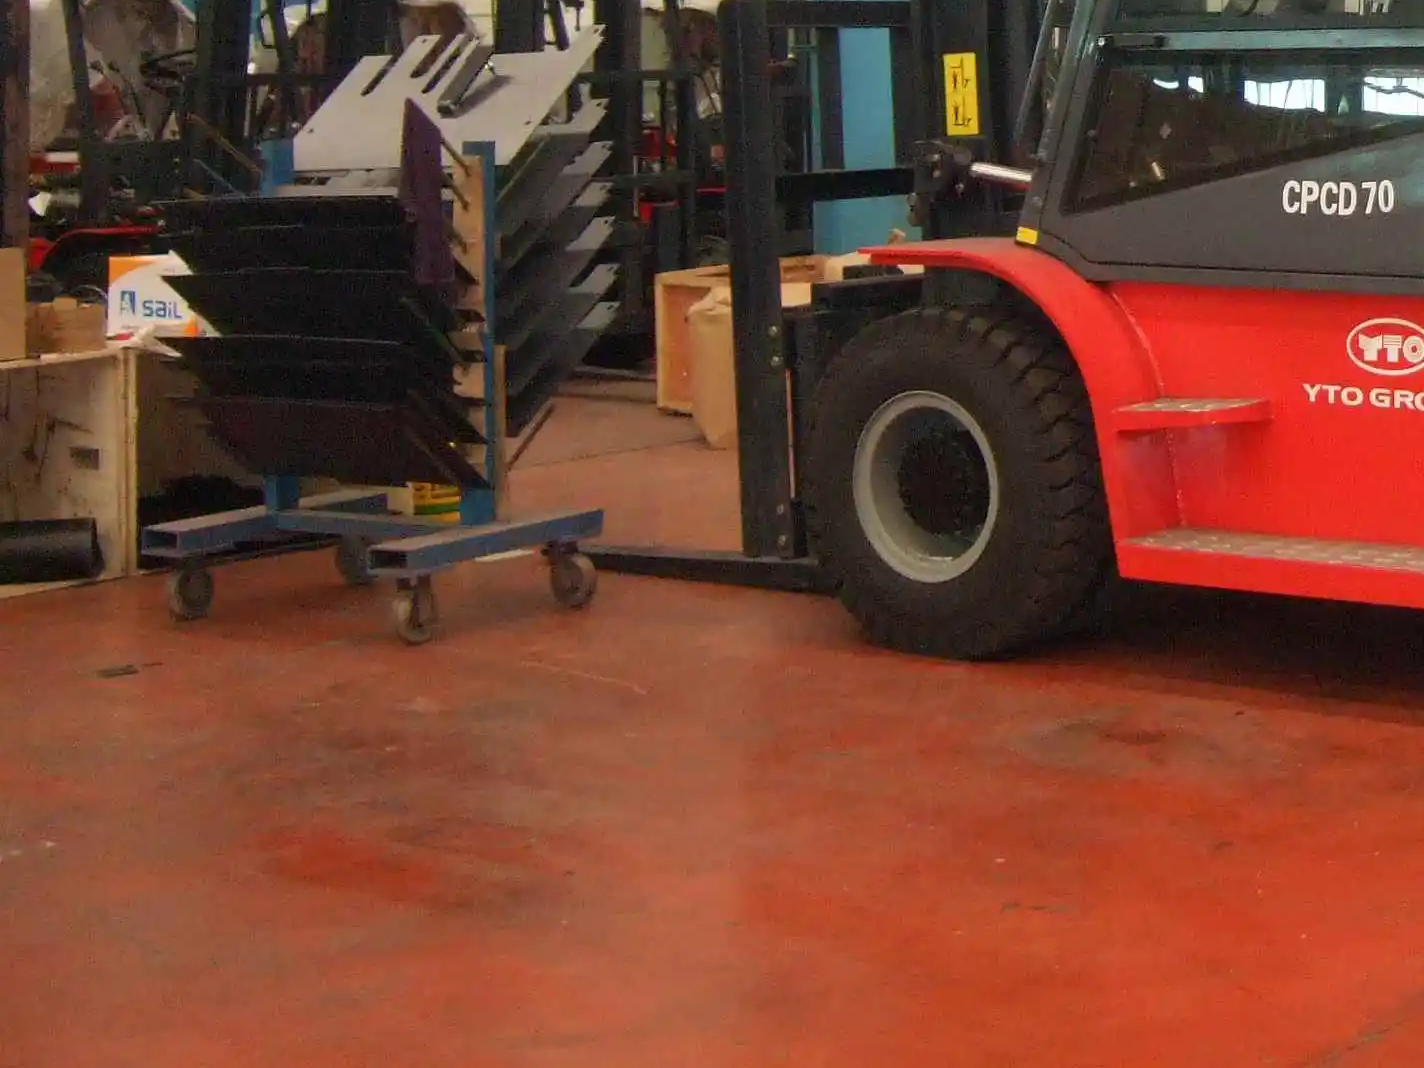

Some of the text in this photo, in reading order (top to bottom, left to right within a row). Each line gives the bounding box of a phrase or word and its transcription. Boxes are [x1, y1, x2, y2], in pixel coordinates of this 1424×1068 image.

[1282, 178, 1396, 216] CPCD 70
[1302, 383, 1364, 407] YTO
